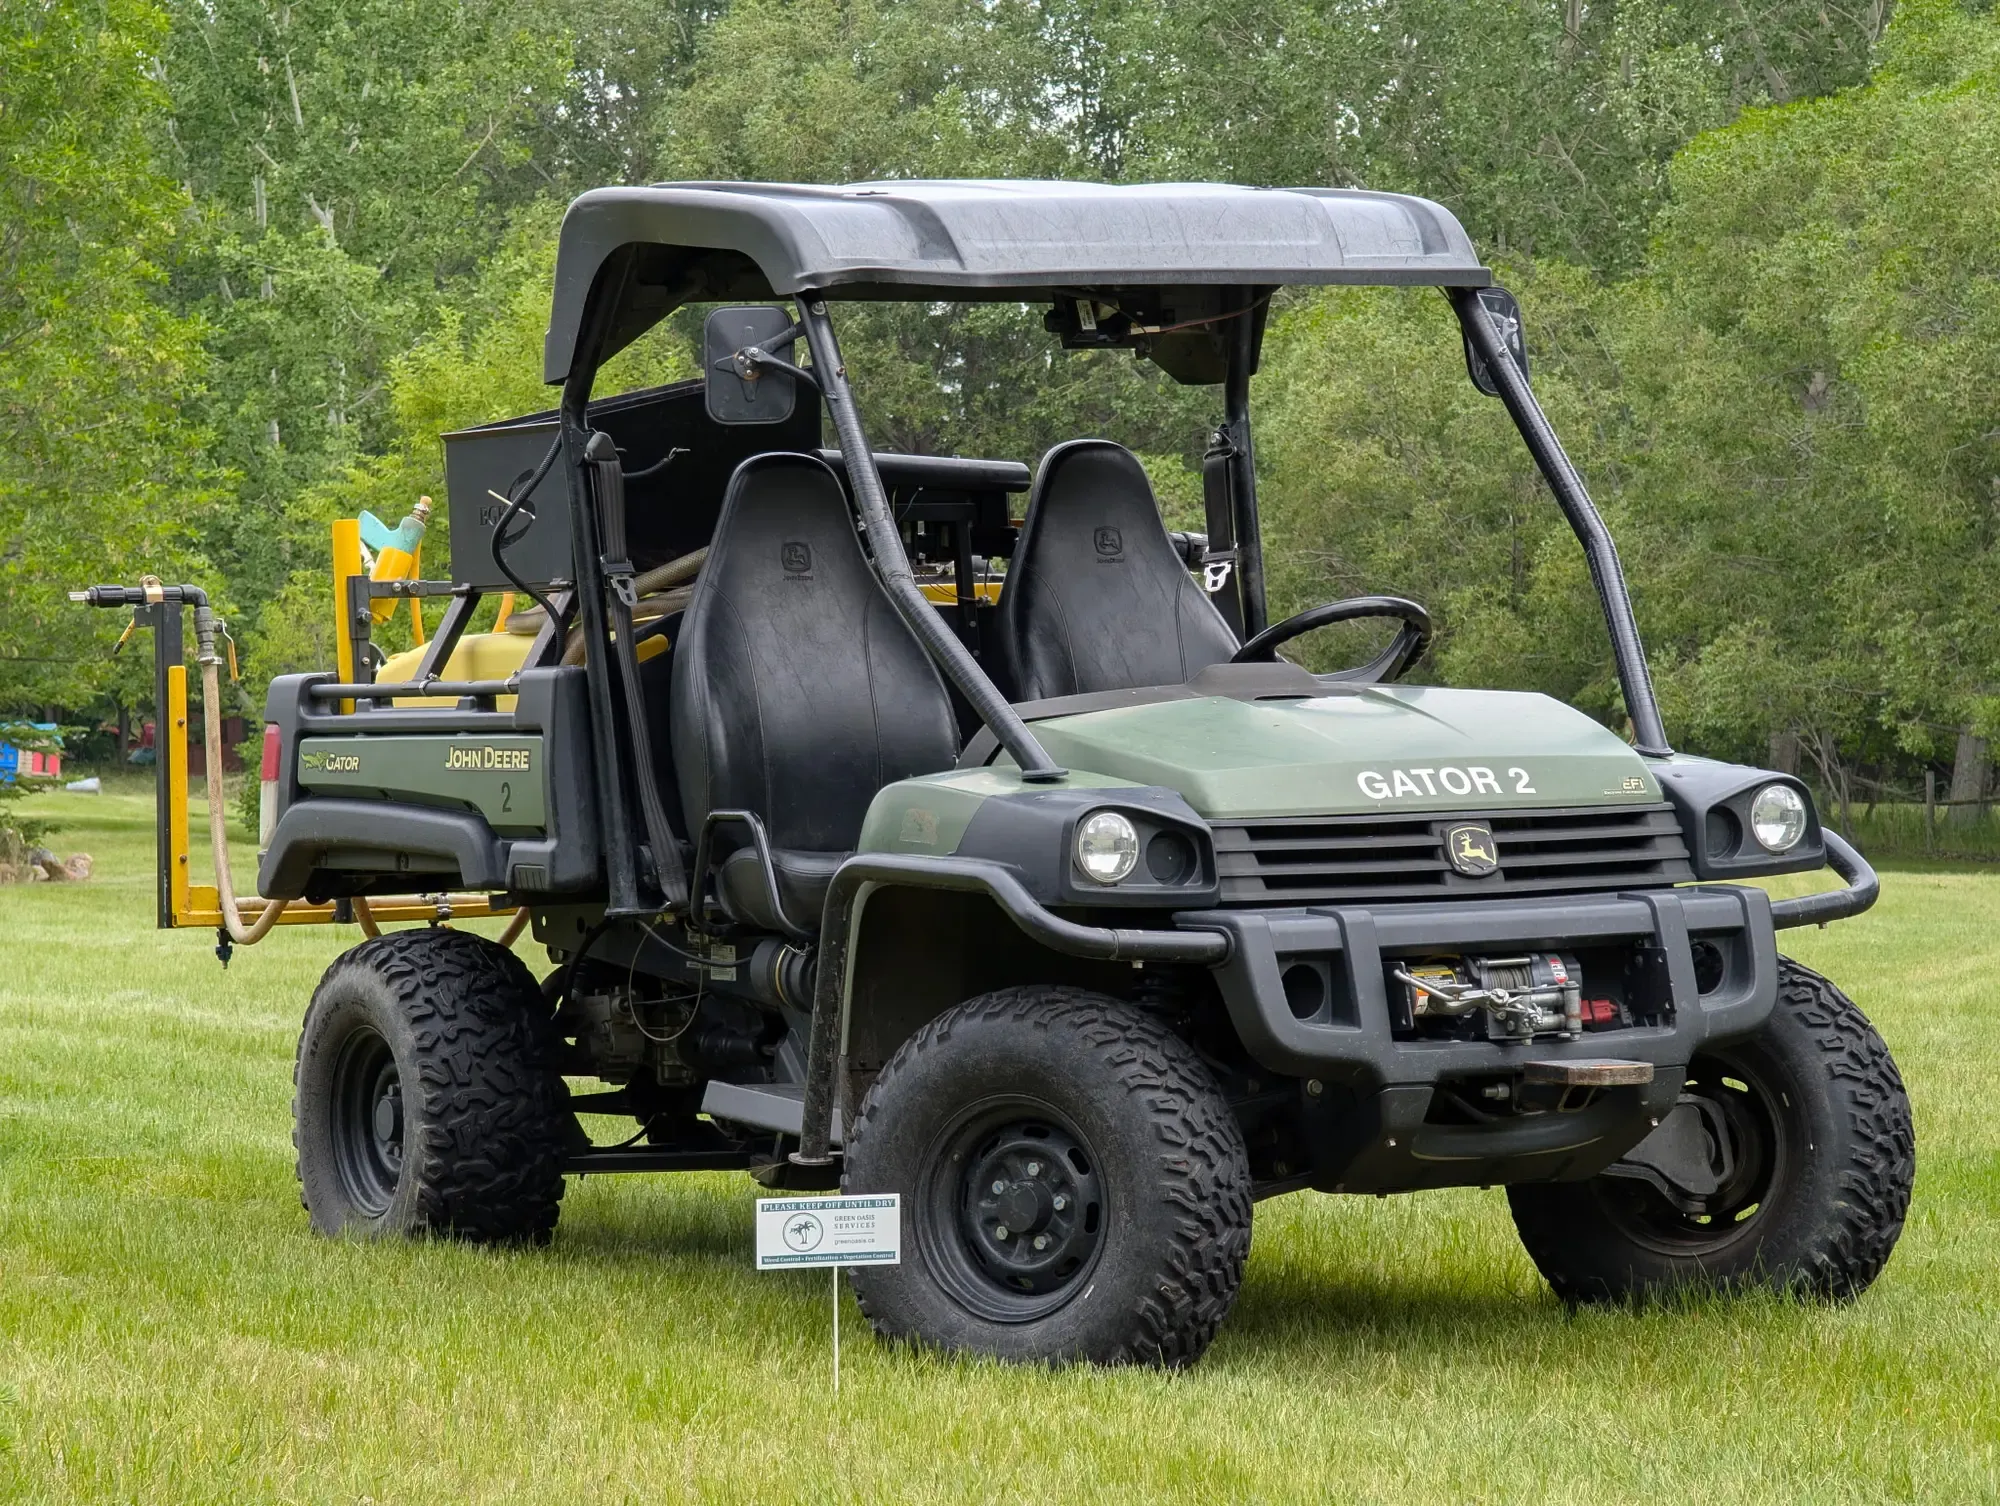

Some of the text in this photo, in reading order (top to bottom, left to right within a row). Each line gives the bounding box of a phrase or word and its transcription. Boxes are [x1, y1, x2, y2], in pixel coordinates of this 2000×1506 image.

[326, 753, 360, 771] GATOR
[445, 745, 530, 770] JOHN DEERE
[1356, 766, 1537, 799] GATOR 2
[1622, 777, 1645, 790] EFI
[501, 781, 512, 813] 2
[763, 1199, 894, 1212] PLEASE KEEP OFF UNTIL DRY
[834, 1222, 876, 1230] SERVICES
[843, 1253, 872, 1261] Vegetation
